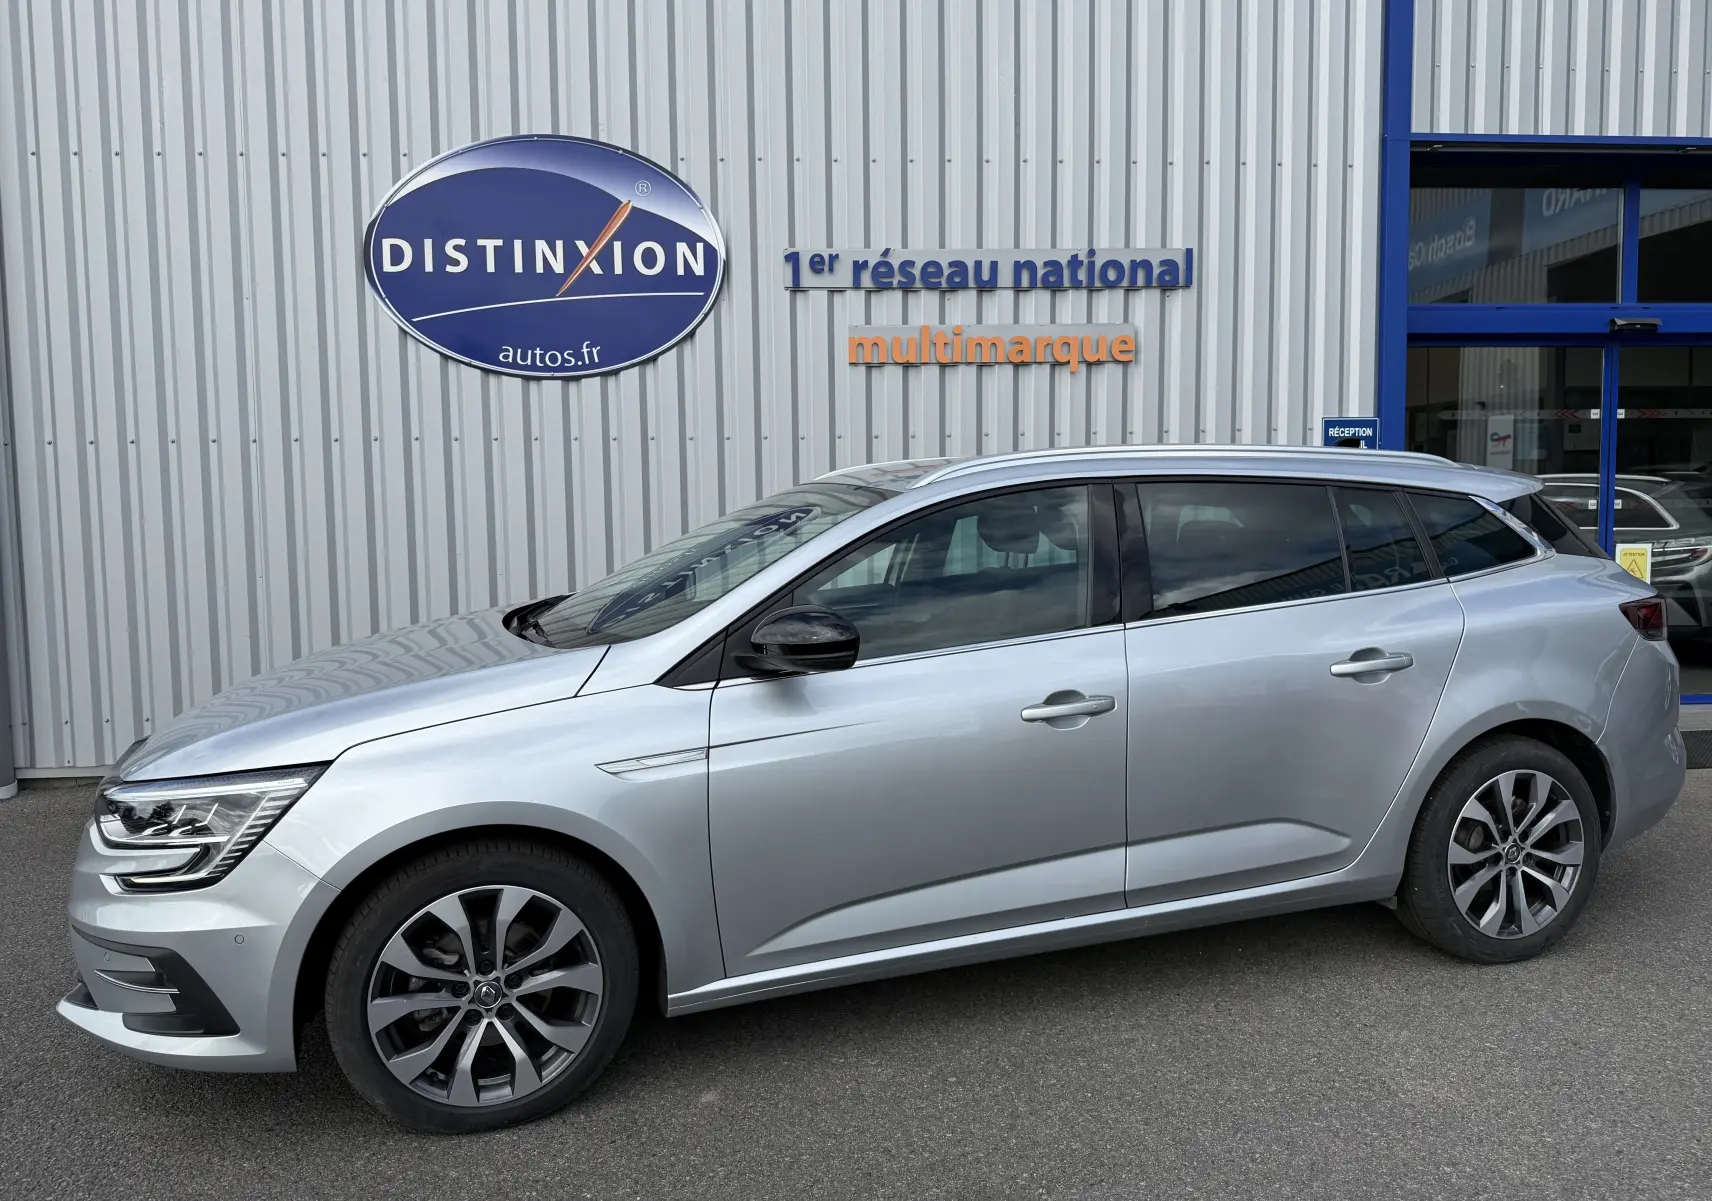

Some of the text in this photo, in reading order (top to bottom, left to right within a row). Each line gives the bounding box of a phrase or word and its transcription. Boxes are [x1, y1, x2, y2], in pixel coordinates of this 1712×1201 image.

[381, 238, 705, 276] DISTINXION
[783, 247, 1194, 288] 1er réseau national
[498, 340, 601, 368] autos.fr
[848, 325, 1136, 372] multimarque
[1328, 425, 1373, 437] RÉCEPTION
